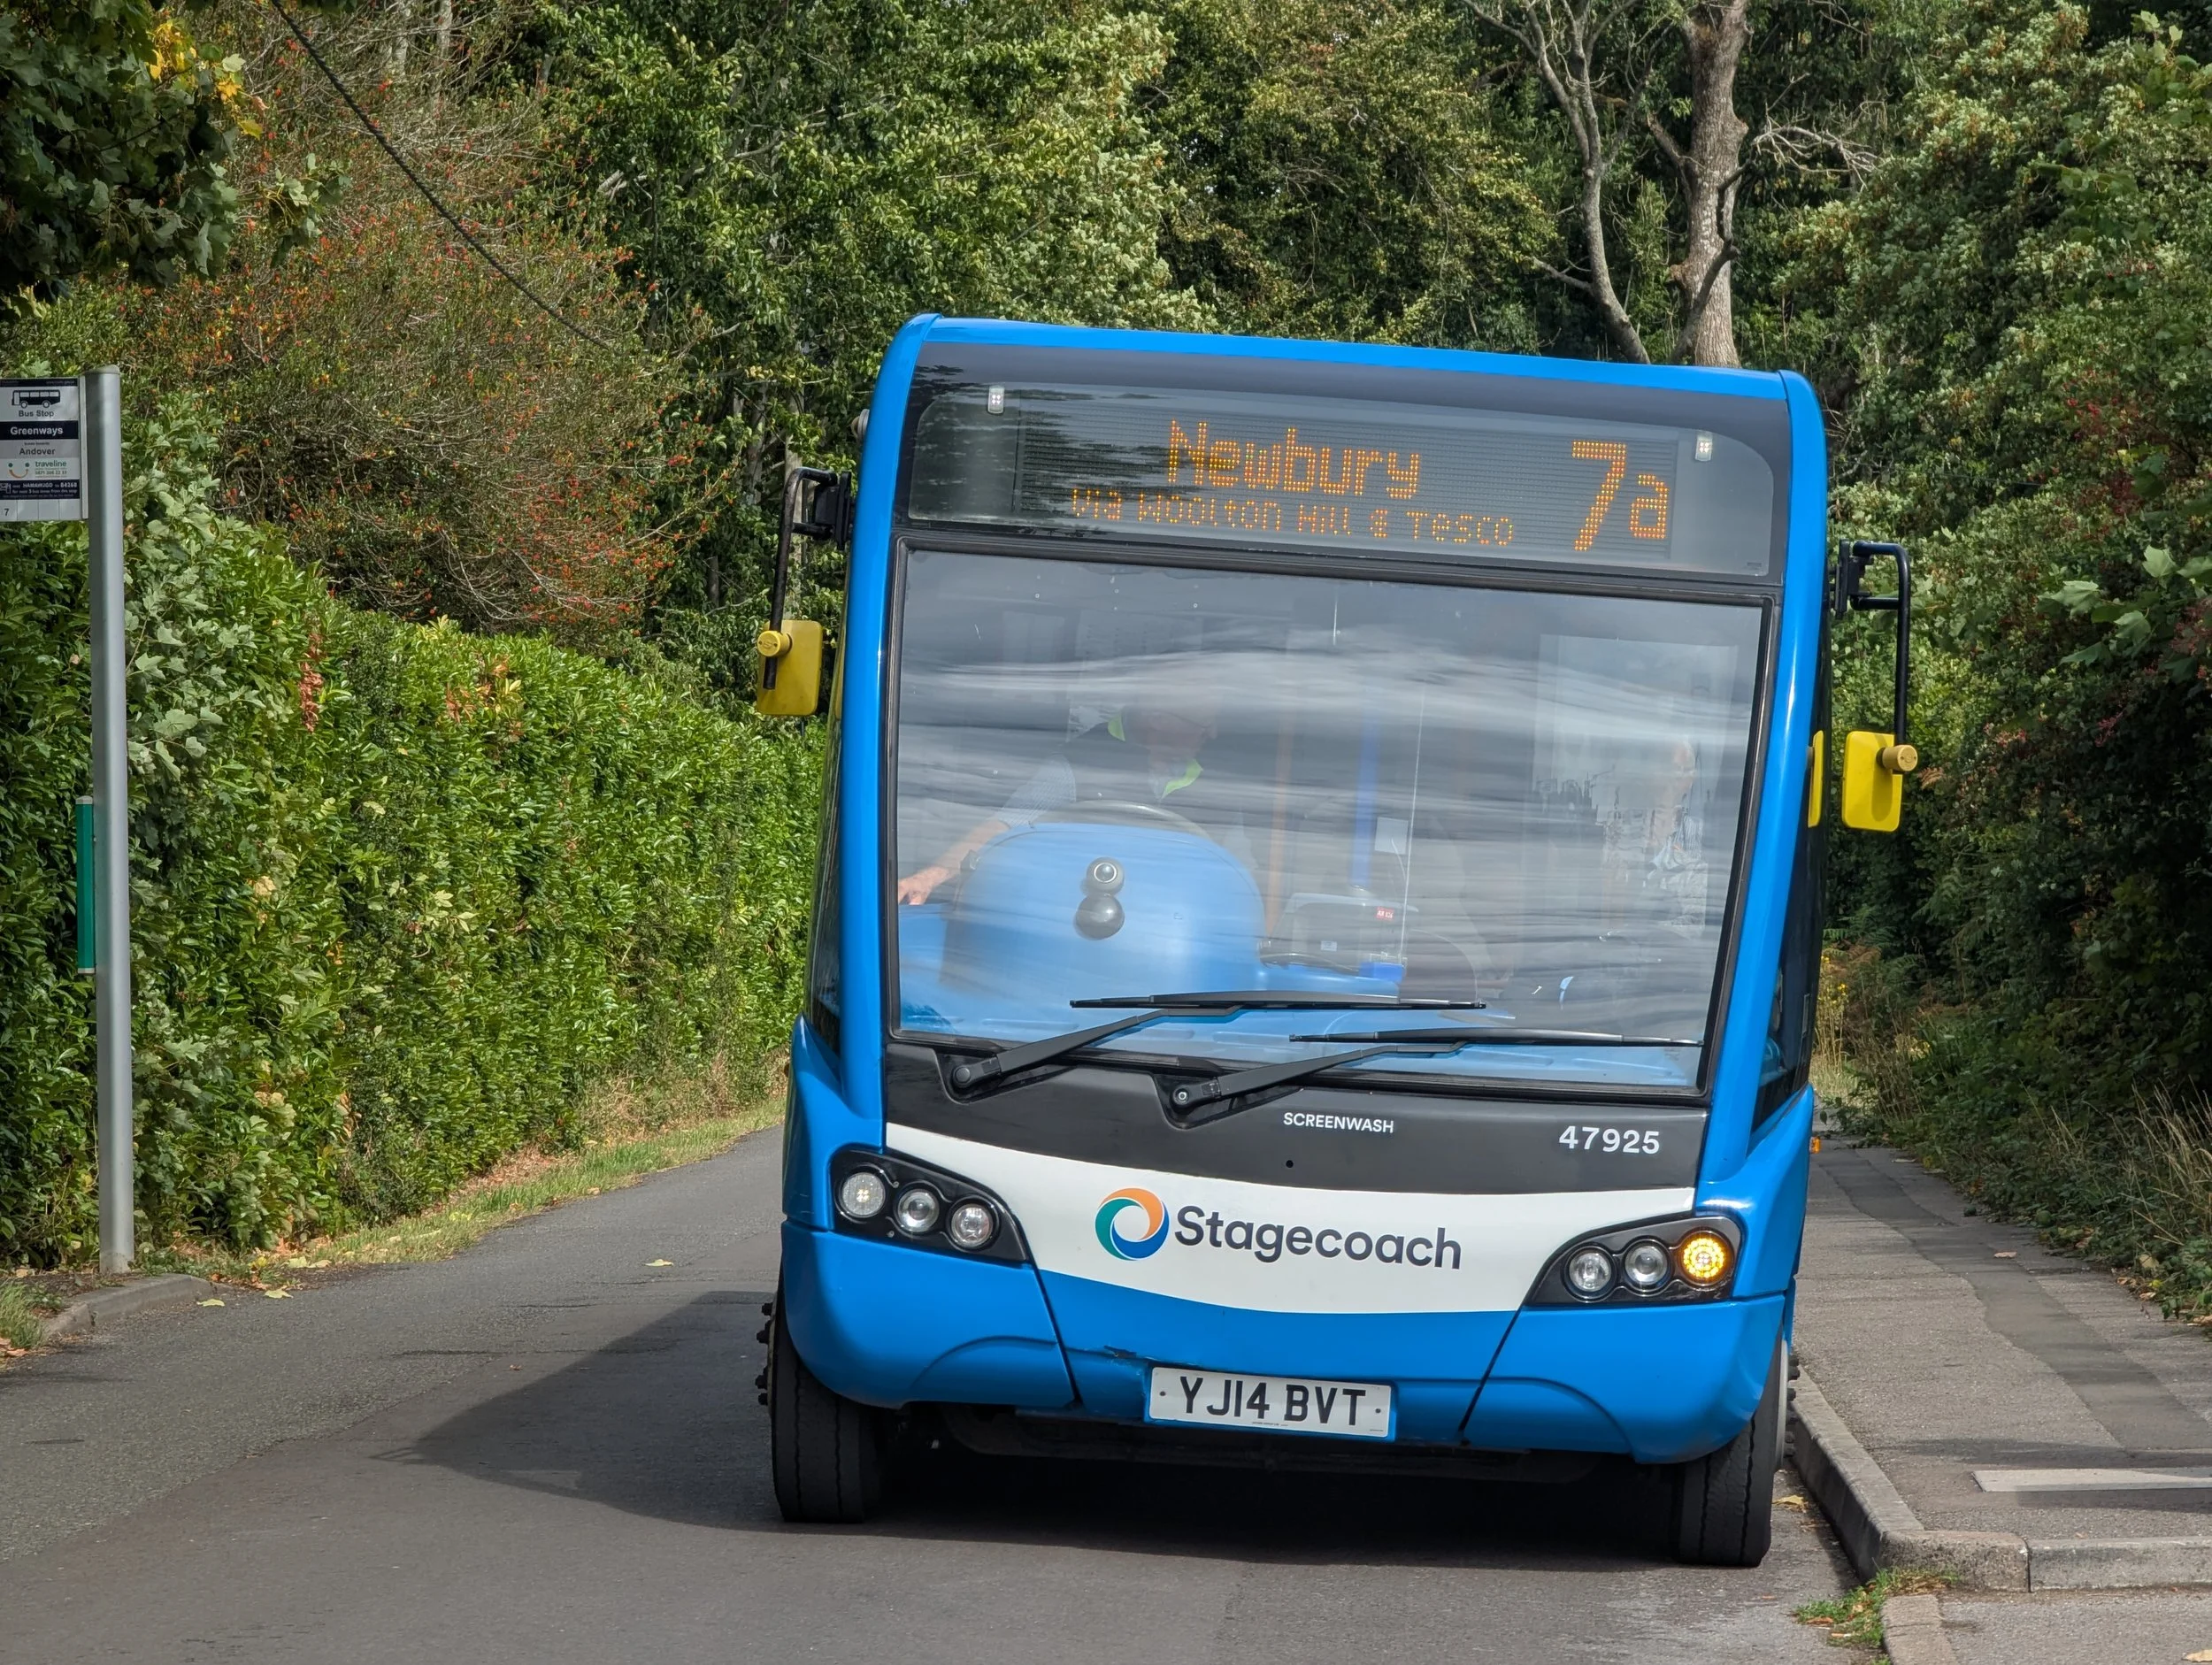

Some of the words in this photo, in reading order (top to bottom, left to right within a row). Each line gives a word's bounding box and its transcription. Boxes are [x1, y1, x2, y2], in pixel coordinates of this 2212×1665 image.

[10, 426, 64, 436] Greenways
[1167, 418, 1419, 499] Newbury
[4, 508, 10, 517] 7
[1138, 491, 1281, 532] Woolton
[1298, 503, 1352, 536] Hill
[1369, 508, 1389, 538] &
[1405, 510, 1515, 546] Tesco
[1571, 439, 1670, 552] 7a
[1282, 1111, 1395, 1134] SCREENWASH
[1558, 1124, 1661, 1154] 47925
[1174, 1205, 1462, 1270] Stagecoach
[1179, 1376, 1271, 1420] YJ14
[1284, 1383, 1367, 1426] BVT
